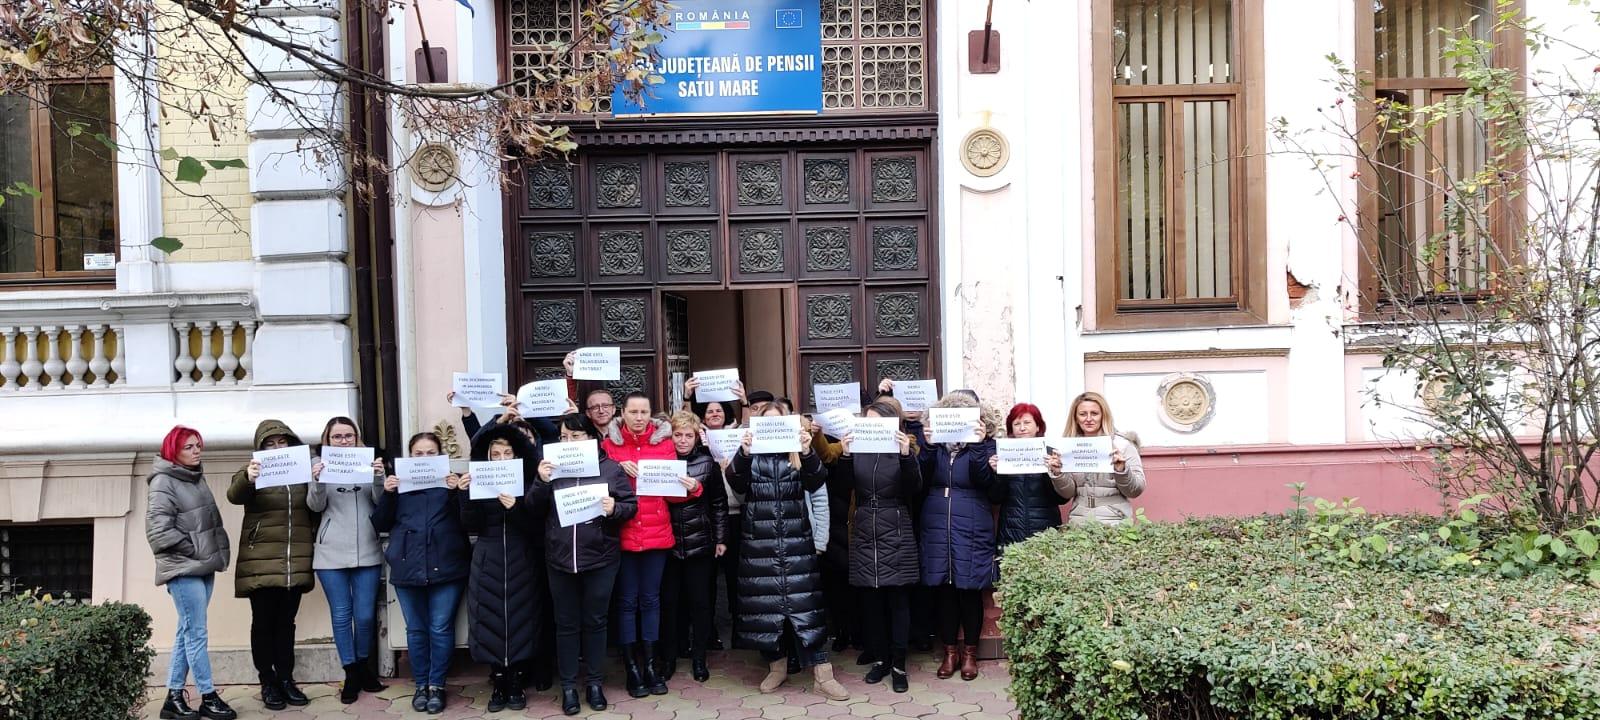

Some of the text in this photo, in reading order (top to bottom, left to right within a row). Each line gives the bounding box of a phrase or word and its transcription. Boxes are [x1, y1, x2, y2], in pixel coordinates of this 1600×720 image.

[676, 10, 750, 20] ROMÂNIA
[659, 54, 738, 78] JUDEȚEANĂ
[746, 56, 762, 72] DE
[768, 54, 814, 72] PENSII
[678, 80, 759, 97] SATU MARE
